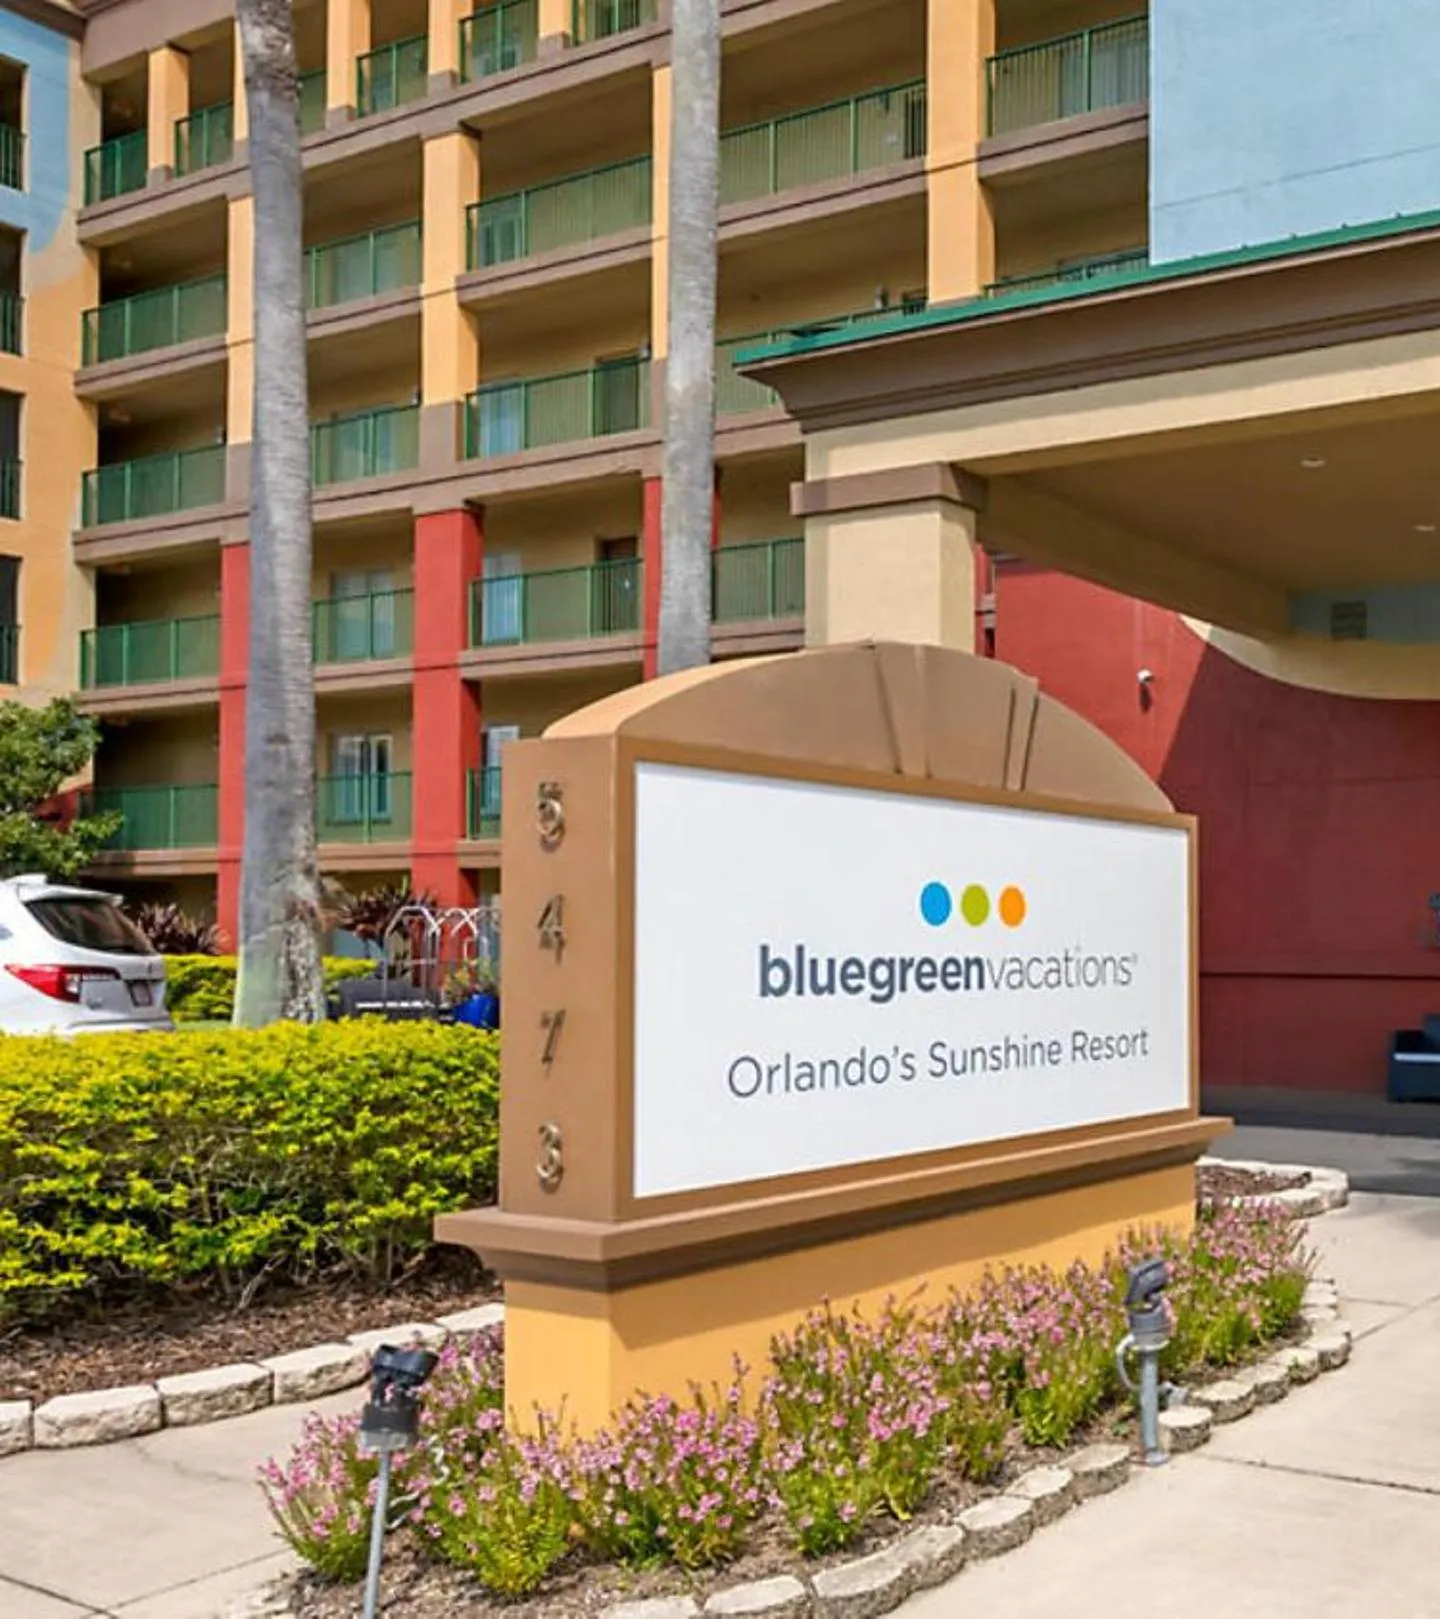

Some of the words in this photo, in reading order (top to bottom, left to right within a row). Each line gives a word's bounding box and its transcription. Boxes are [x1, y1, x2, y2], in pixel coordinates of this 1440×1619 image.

[727, 1045, 917, 1099] Orlando’s
[927, 1033, 1063, 1079] Sunshine
[1071, 1028, 1149, 1063] Resort
